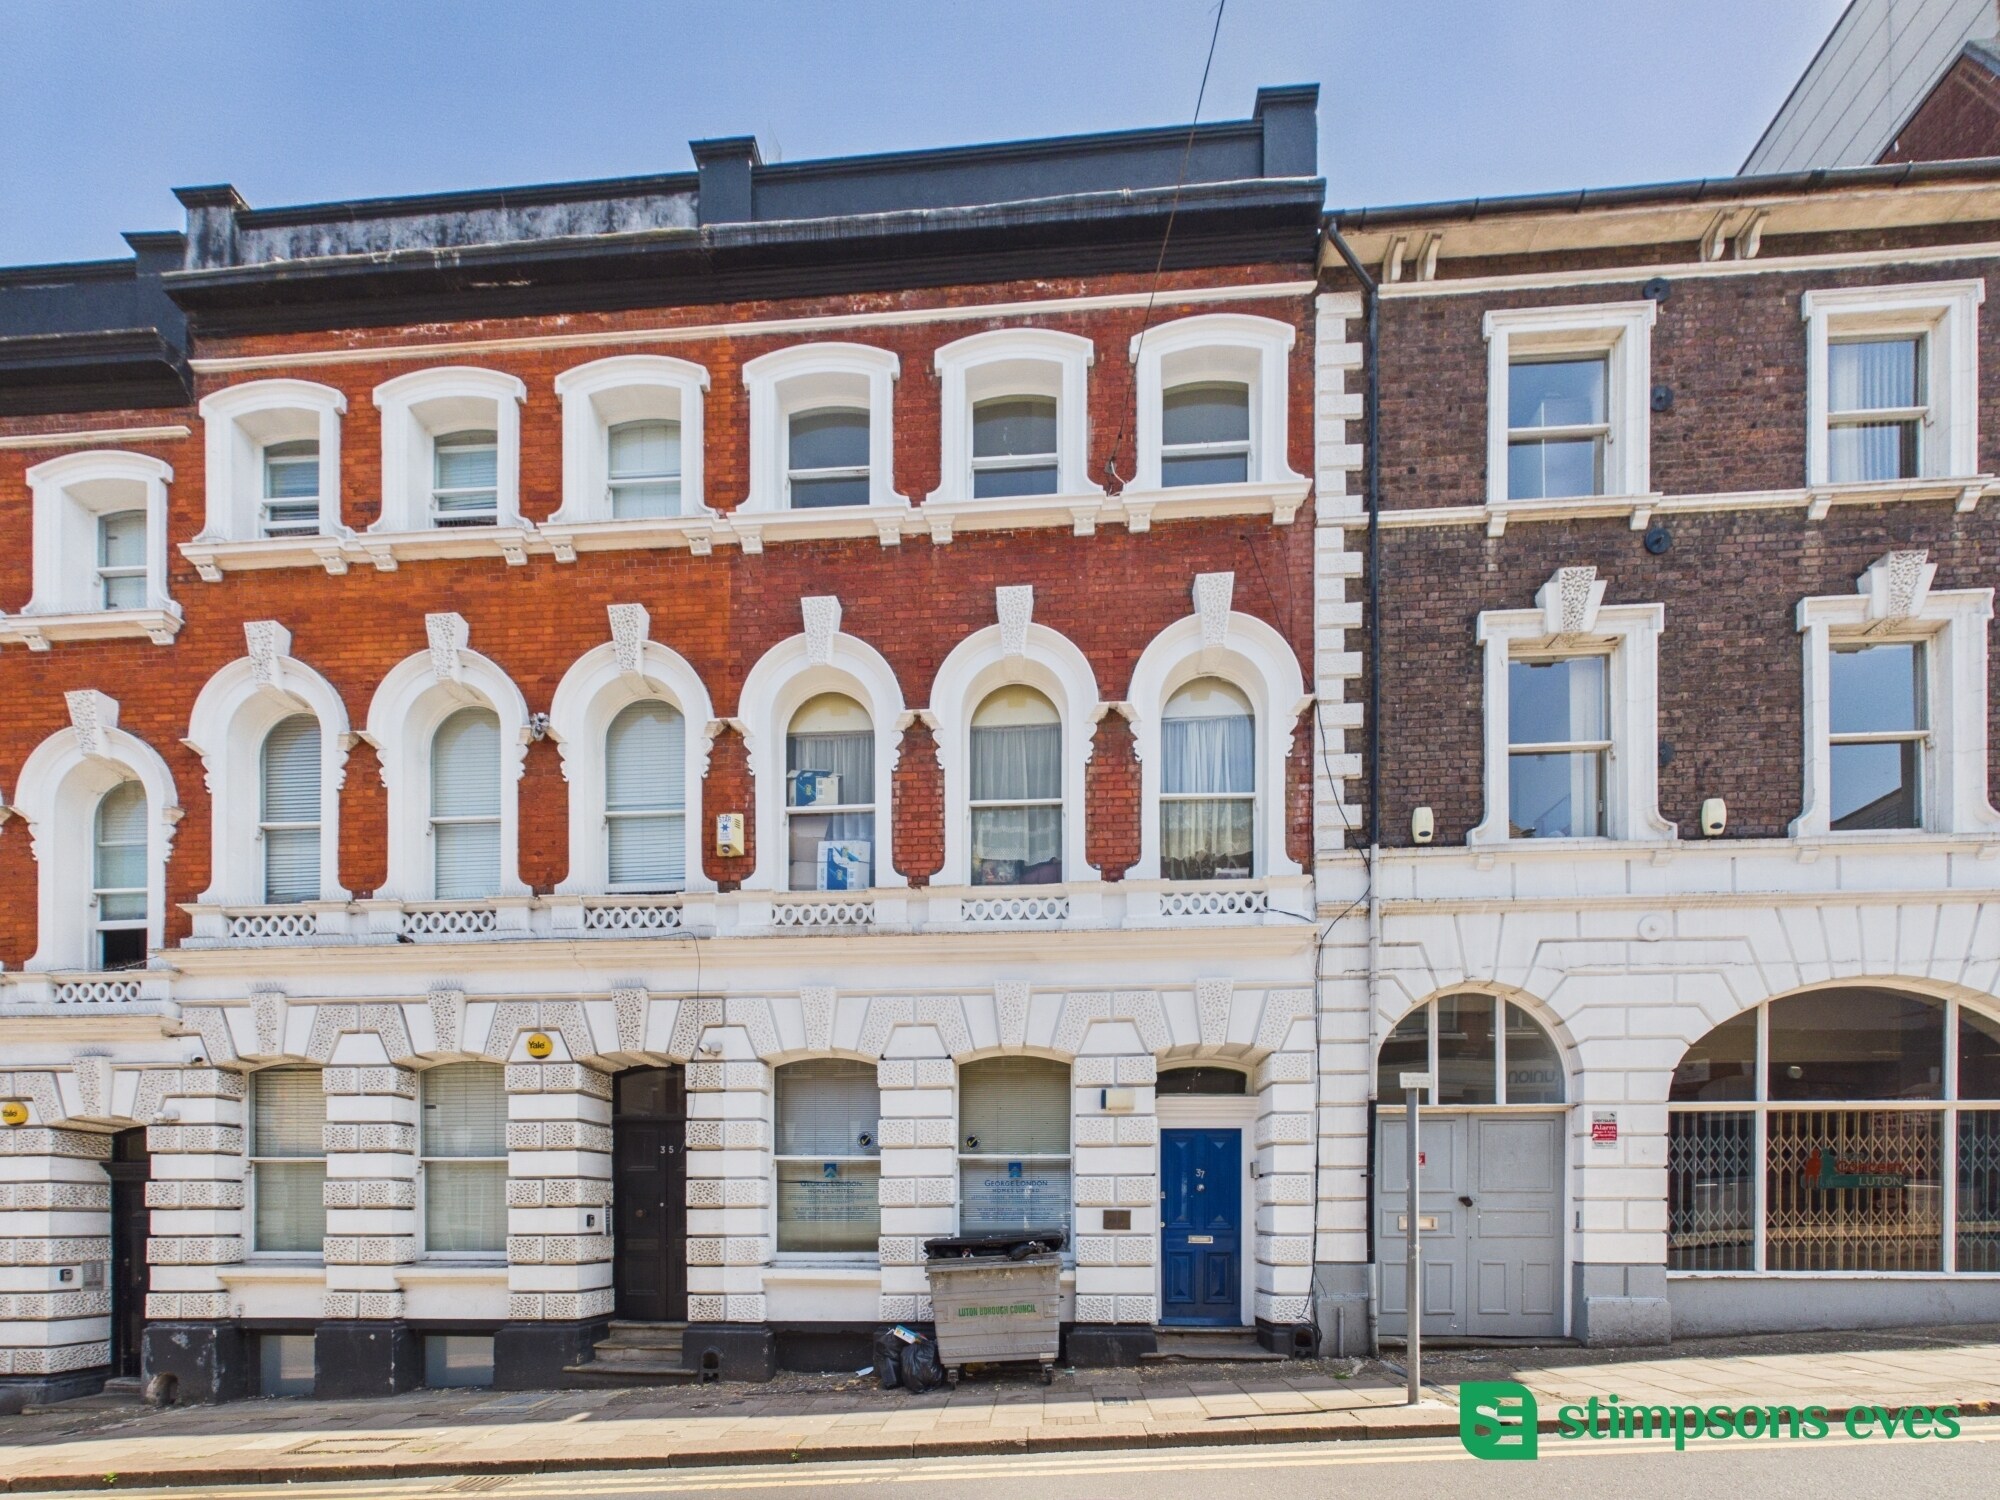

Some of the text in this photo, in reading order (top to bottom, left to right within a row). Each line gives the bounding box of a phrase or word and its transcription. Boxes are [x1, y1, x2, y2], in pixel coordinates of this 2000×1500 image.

[528, 1041, 546, 1049] Yale
[660, 1145, 675, 1154] 35
[1195, 1168, 1206, 1179] 37
[984, 1179, 1049, 1187] GEORGE LONDON
[1858, 1176, 1903, 1186] LUTON
[958, 1304, 1037, 1317] LUTON BOROUGH COUNCIL
